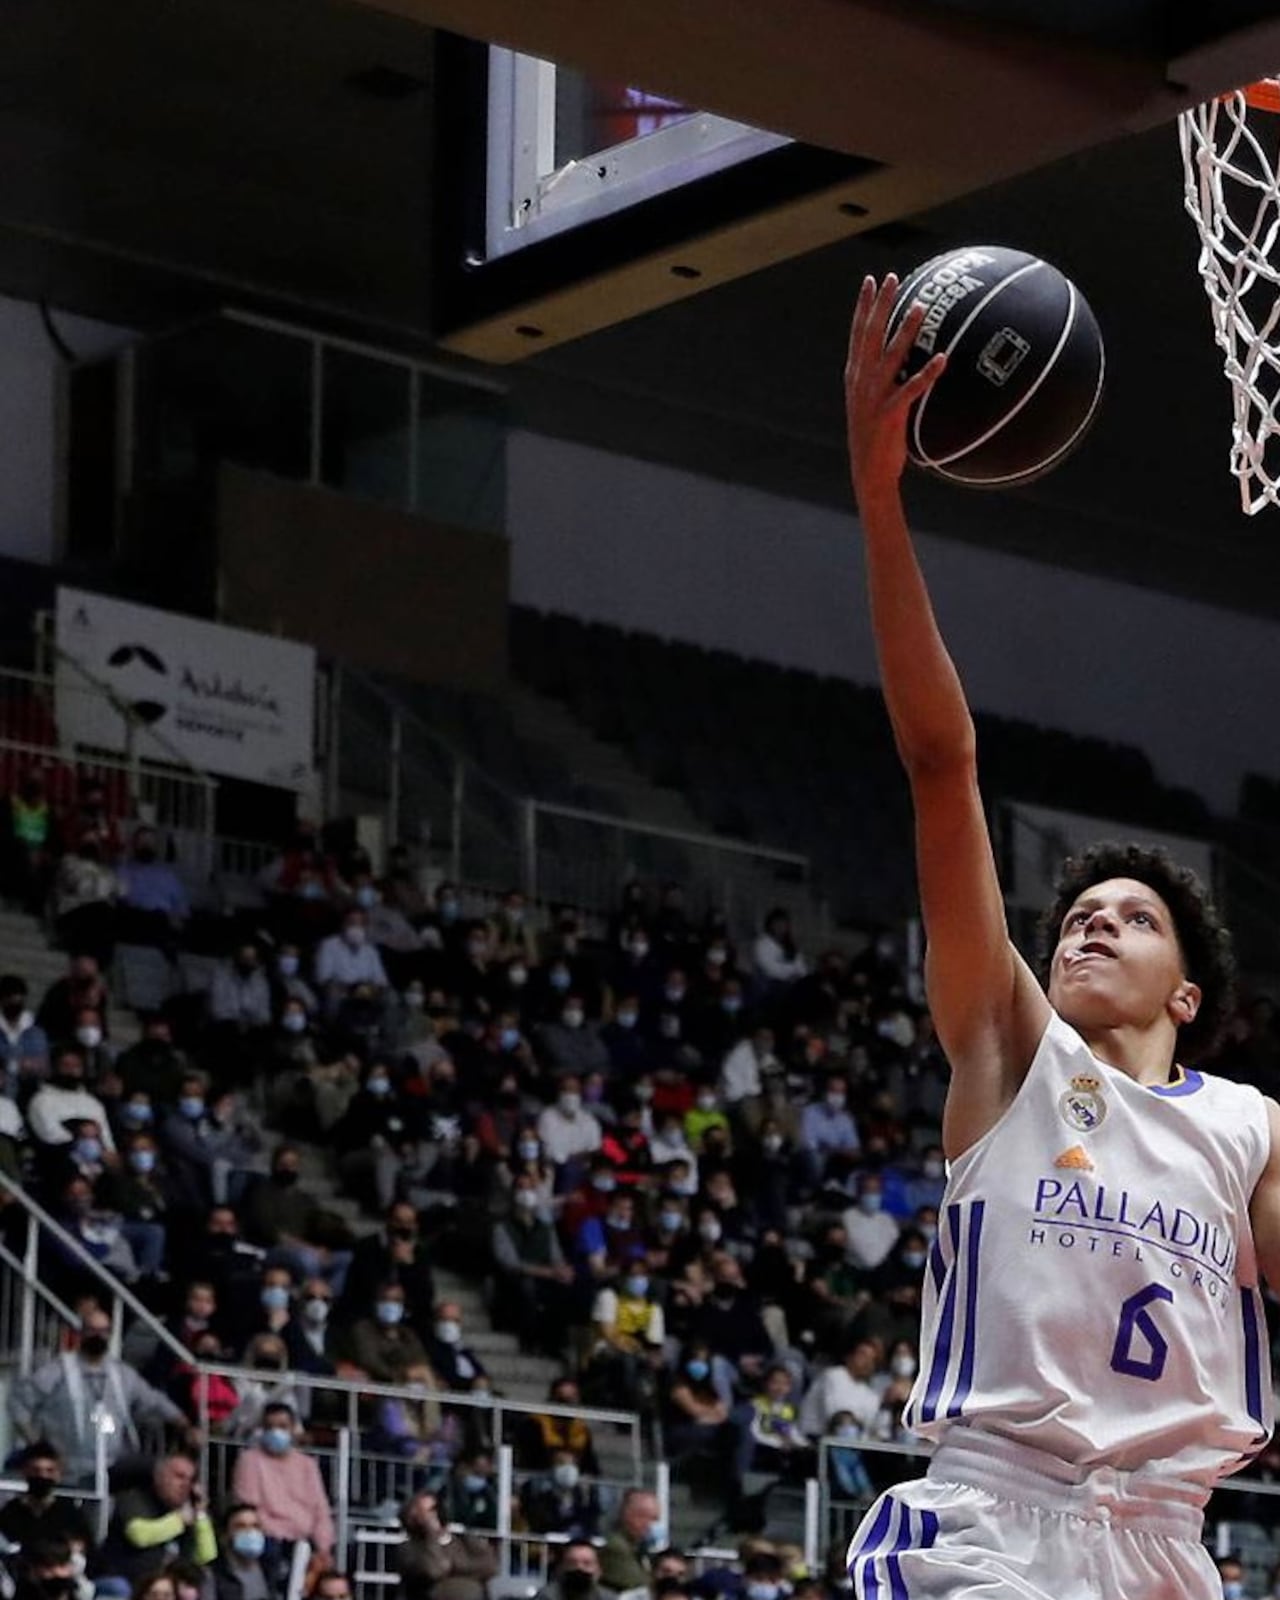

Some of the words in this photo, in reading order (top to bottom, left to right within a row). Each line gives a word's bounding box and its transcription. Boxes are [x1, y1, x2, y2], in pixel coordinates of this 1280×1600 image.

[914, 275, 985, 354] ENDESA
[1029, 1228, 1144, 1263] HOTEL
[1109, 1281, 1174, 1382] 6
